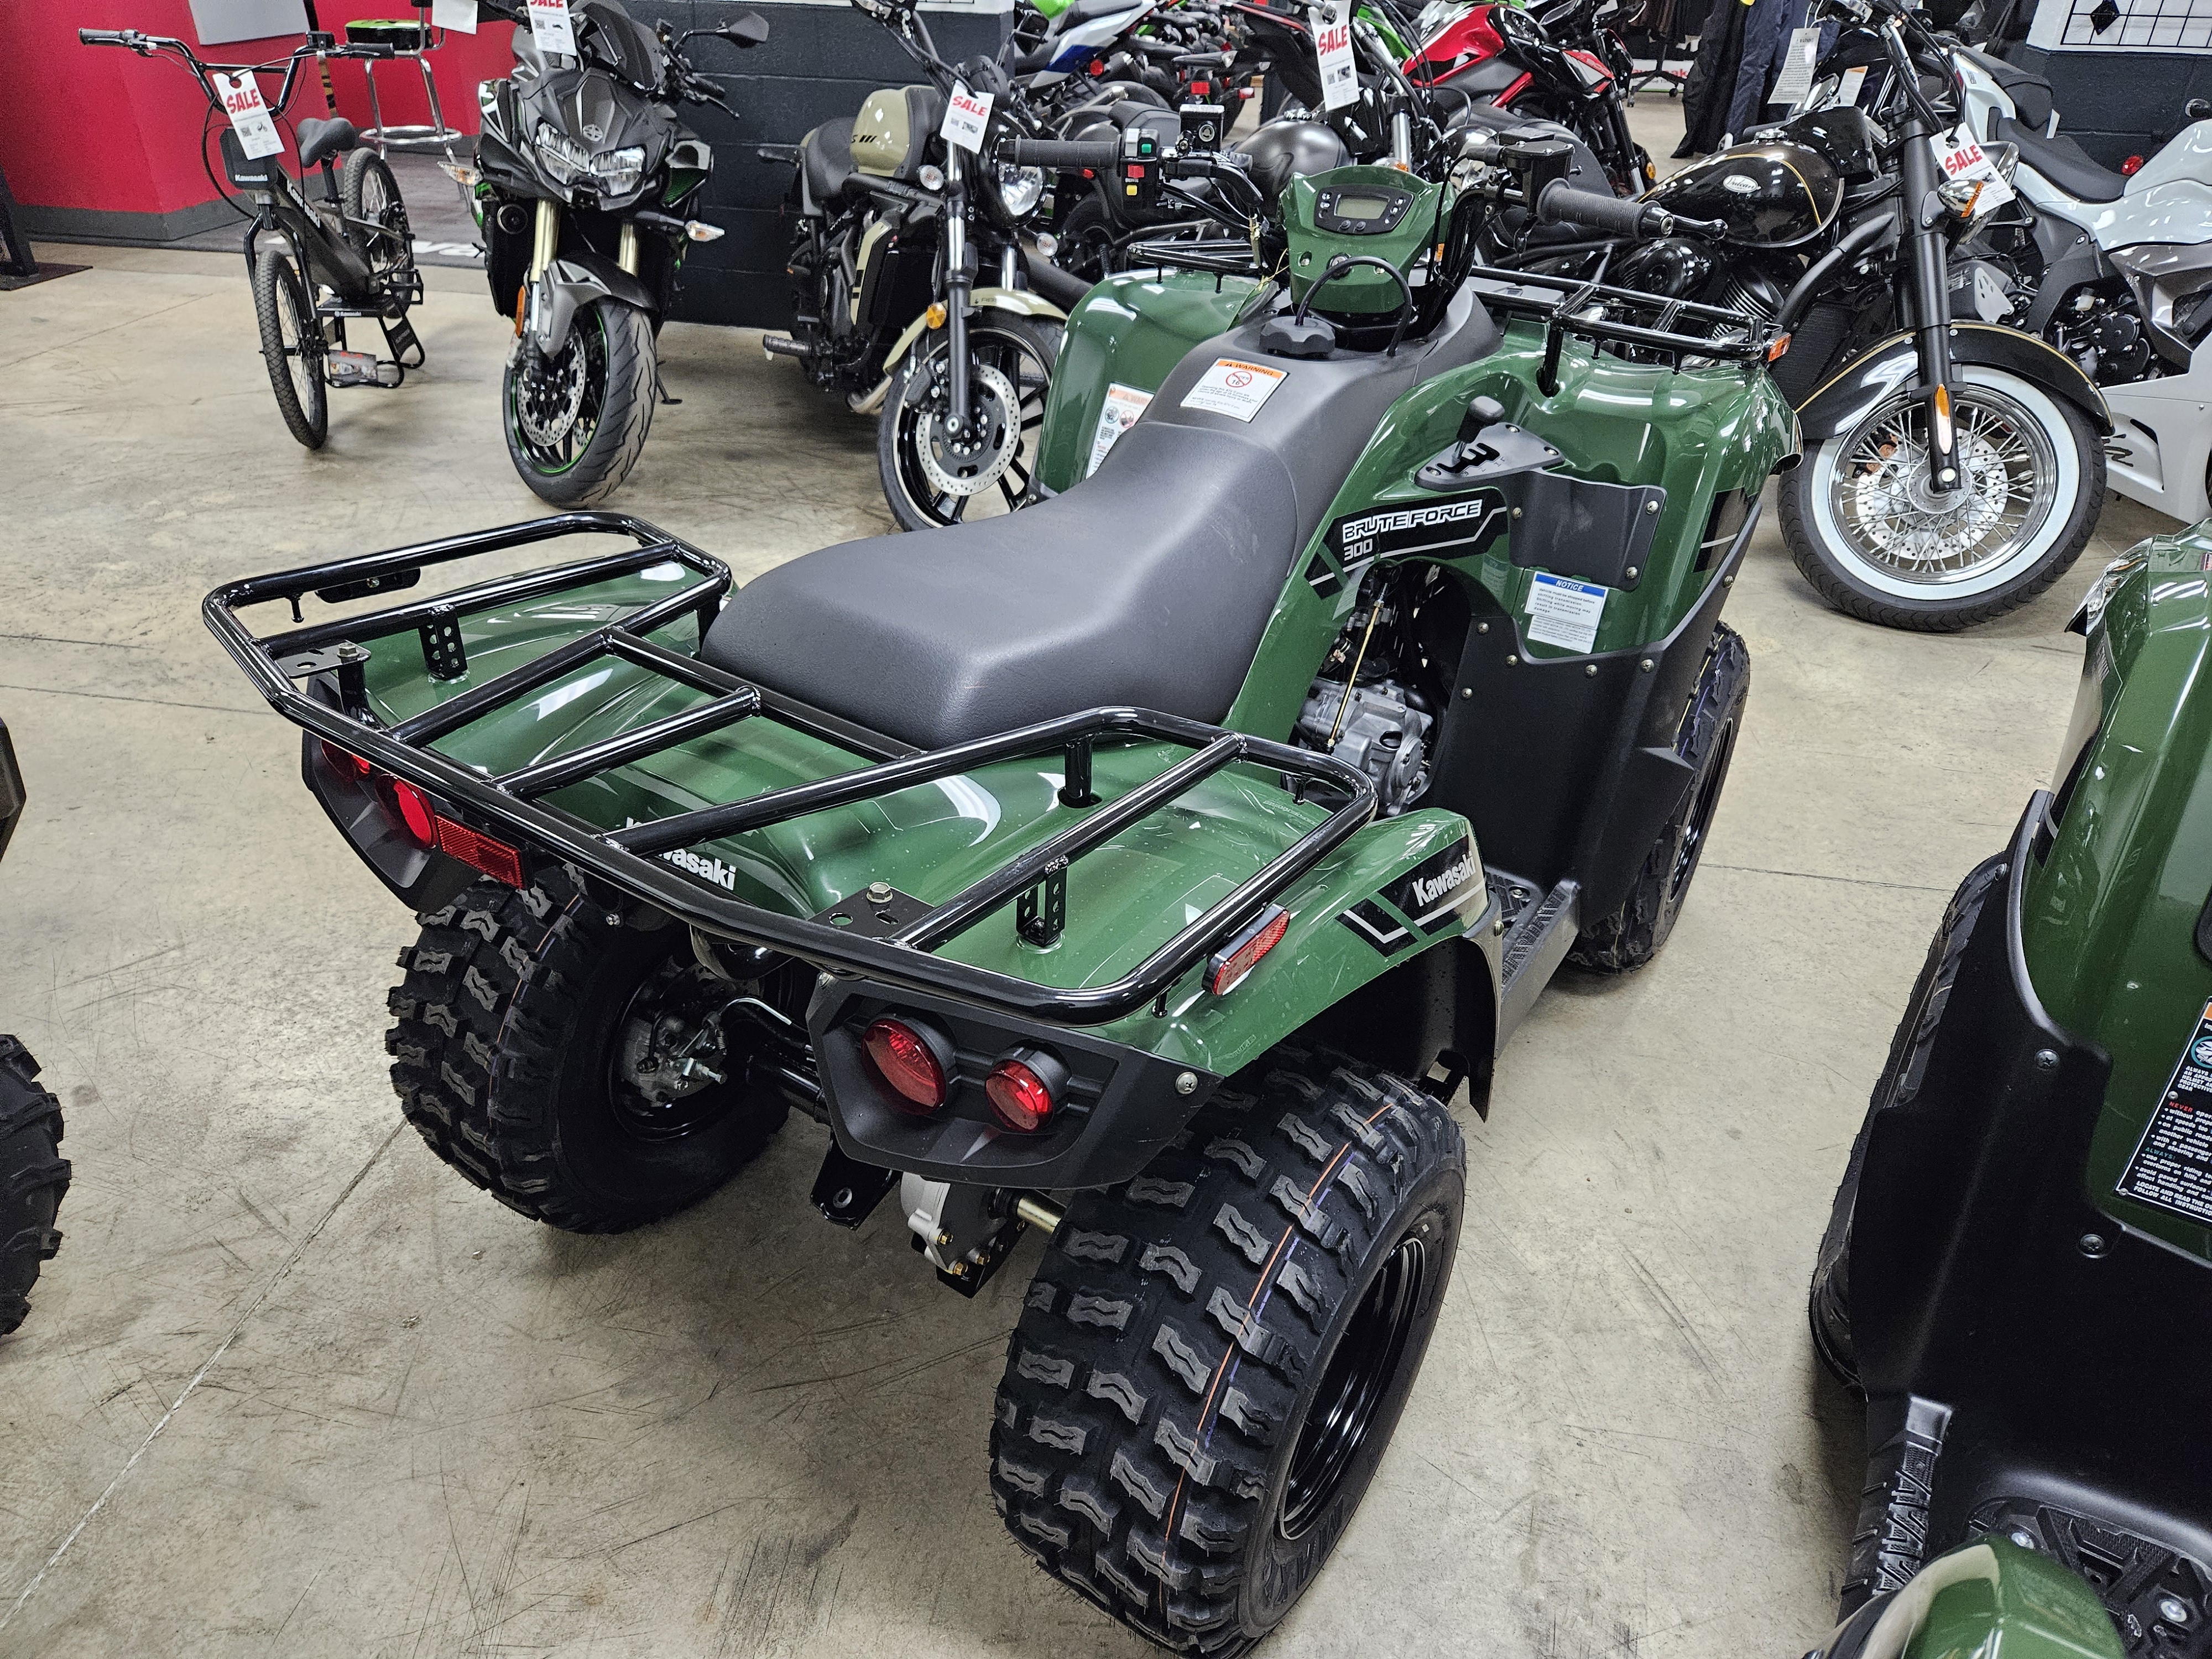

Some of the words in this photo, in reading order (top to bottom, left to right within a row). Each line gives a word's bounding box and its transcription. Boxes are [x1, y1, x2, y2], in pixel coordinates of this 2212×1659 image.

[1318, 24, 1348, 56] SALE
[226, 88, 260, 114] SALE
[953, 96, 987, 117] SALE
[1945, 144, 1983, 175] SALE
[1726, 177, 1755, 189] Vulcan
[1235, 363, 1274, 376] WARNING
[1343, 511, 1410, 543] BRUTE
[1408, 499, 1483, 528] FORCE
[1344, 538, 1373, 561] 300
[1556, 580, 1584, 592] NOTICE
[1553, 607, 1580, 615] transmission
[1412, 850, 1476, 907] Kawasaki
[2185, 1065, 2209, 1076] ALWAYS
[2177, 1083, 2193, 1092] GEAR
[2182, 1074, 2204, 1085] HELMET
[2169, 1102, 2193, 1113] NEVER
[2169, 1109, 2193, 1120] without
[2173, 1125, 2193, 1135] public
[2175, 1118, 2196, 1128] speeds
[2156, 1135, 2170, 1144] with
[2179, 1143, 2212, 1156] passenger
[2159, 1129, 2184, 1139] another
[2186, 1138, 2209, 1148] vehicle
[2167, 1145, 2194, 1158] steering
[2139, 1167, 2157, 1176] avoid
[2158, 1173, 2178, 1183] paved
[2143, 1160, 2171, 1172] overturns
[2184, 1172, 2197, 1181] hills
[2159, 1159, 2182, 1168] proper
[2184, 1166, 2203, 1177] riding
[2136, 1172, 2155, 1182] affect
[2157, 1179, 2184, 1192] handling
[2133, 1186, 2159, 1198] FOLLOW
[2160, 1194, 2172, 1203] ALL
[2136, 1181, 2160, 1192] LOCATE
[2160, 1188, 2174, 1197] AND
[2174, 1193, 2191, 1203] READ
[2192, 1198, 2205, 1207] THE
